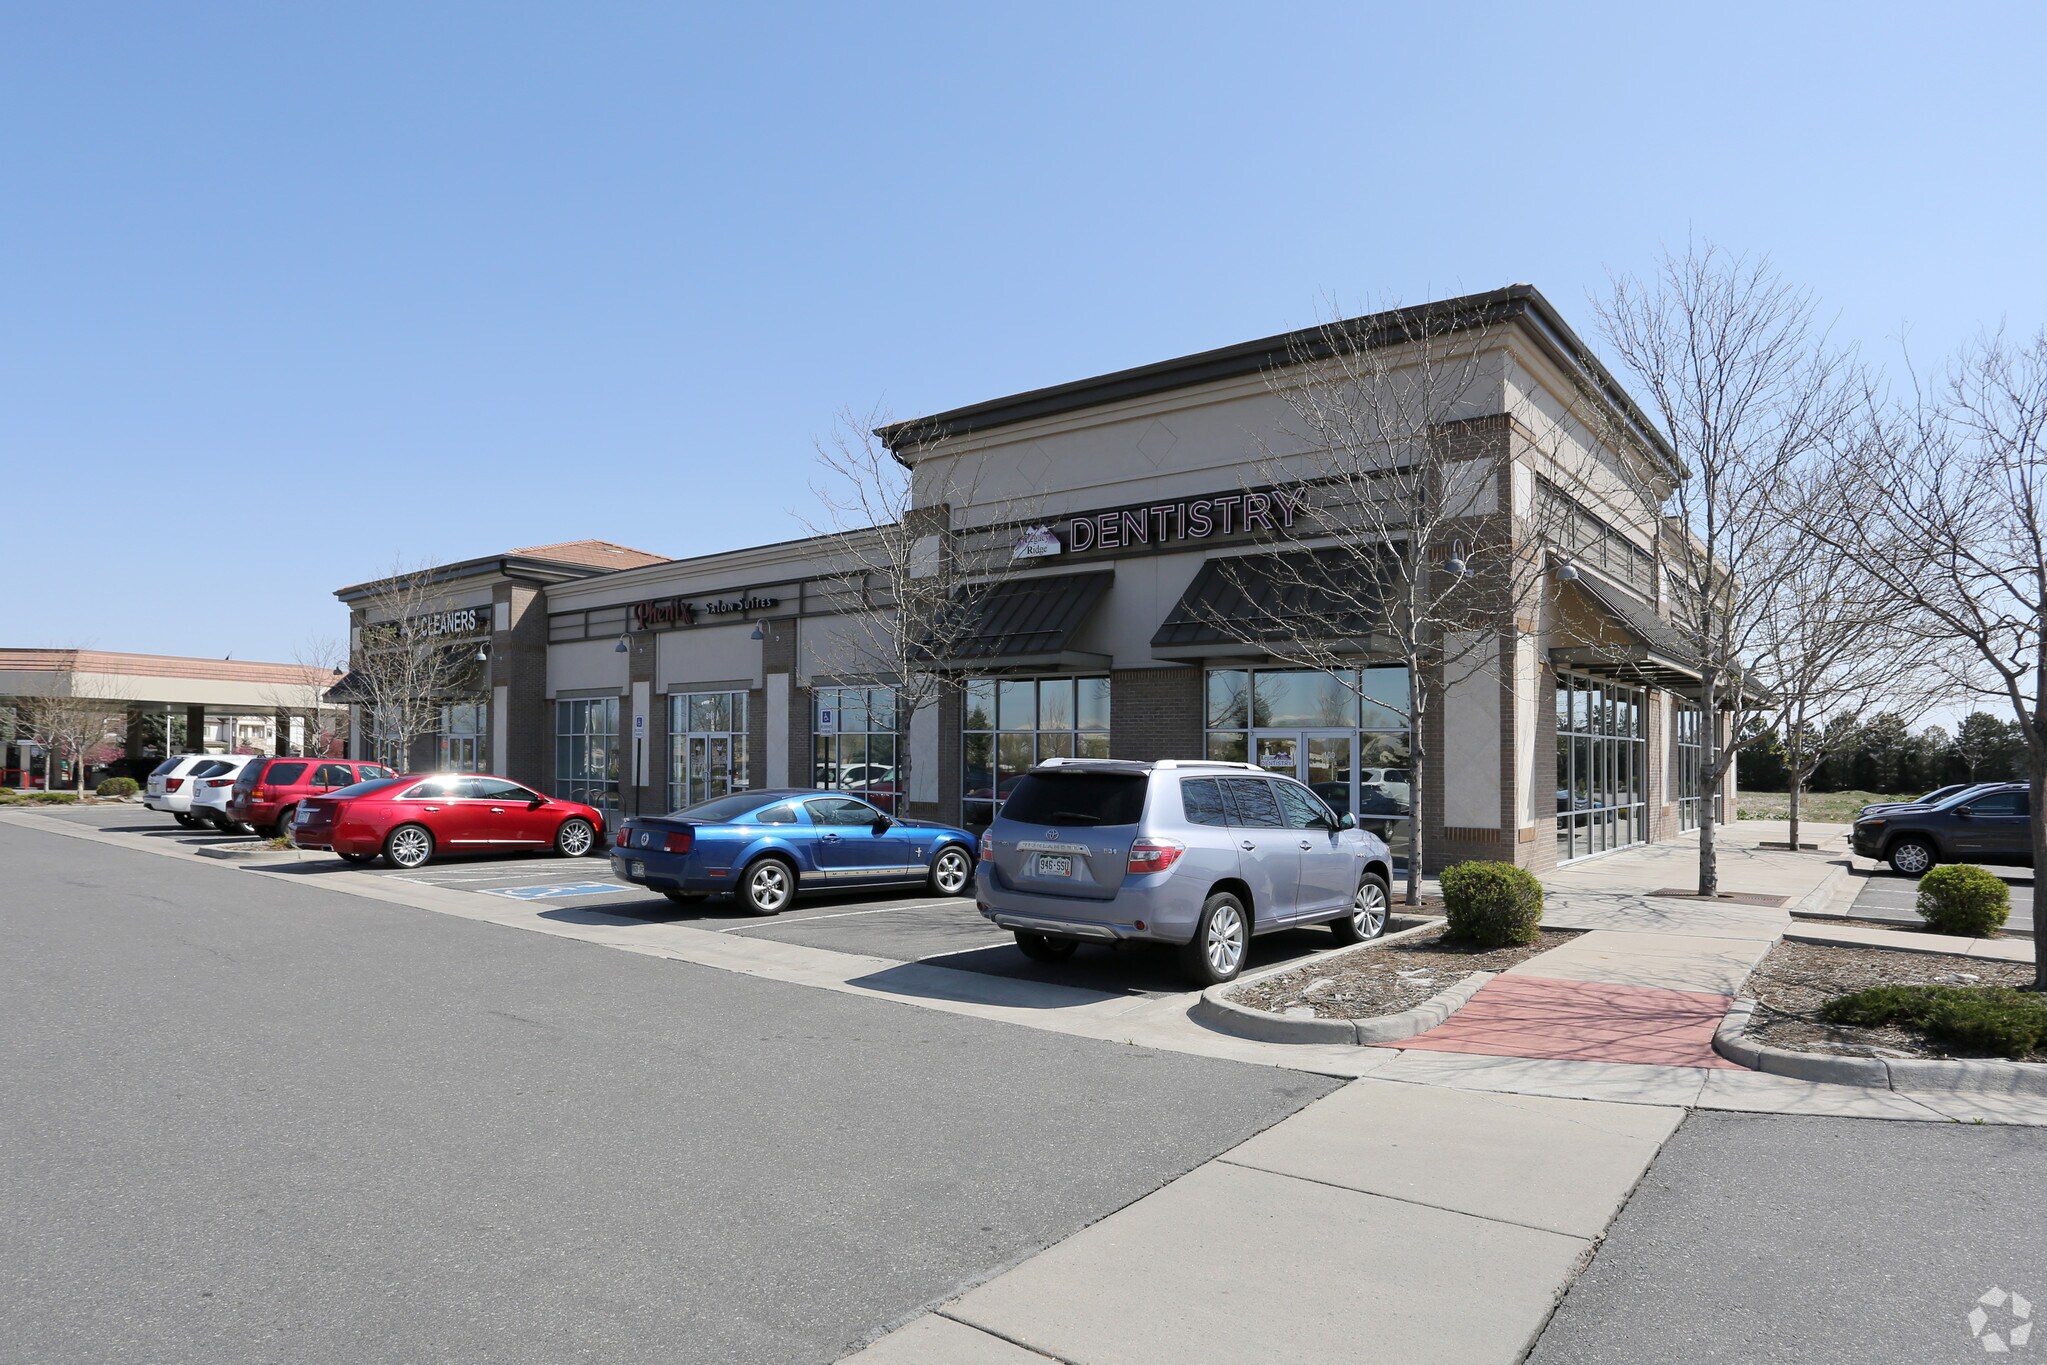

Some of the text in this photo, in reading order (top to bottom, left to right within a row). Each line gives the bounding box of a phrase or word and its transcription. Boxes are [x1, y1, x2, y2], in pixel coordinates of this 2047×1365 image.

[1070, 487, 1305, 552] DENTISTRY
[1027, 545, 1048, 555] Ridge
[421, 609, 476, 636] CLEANERS
